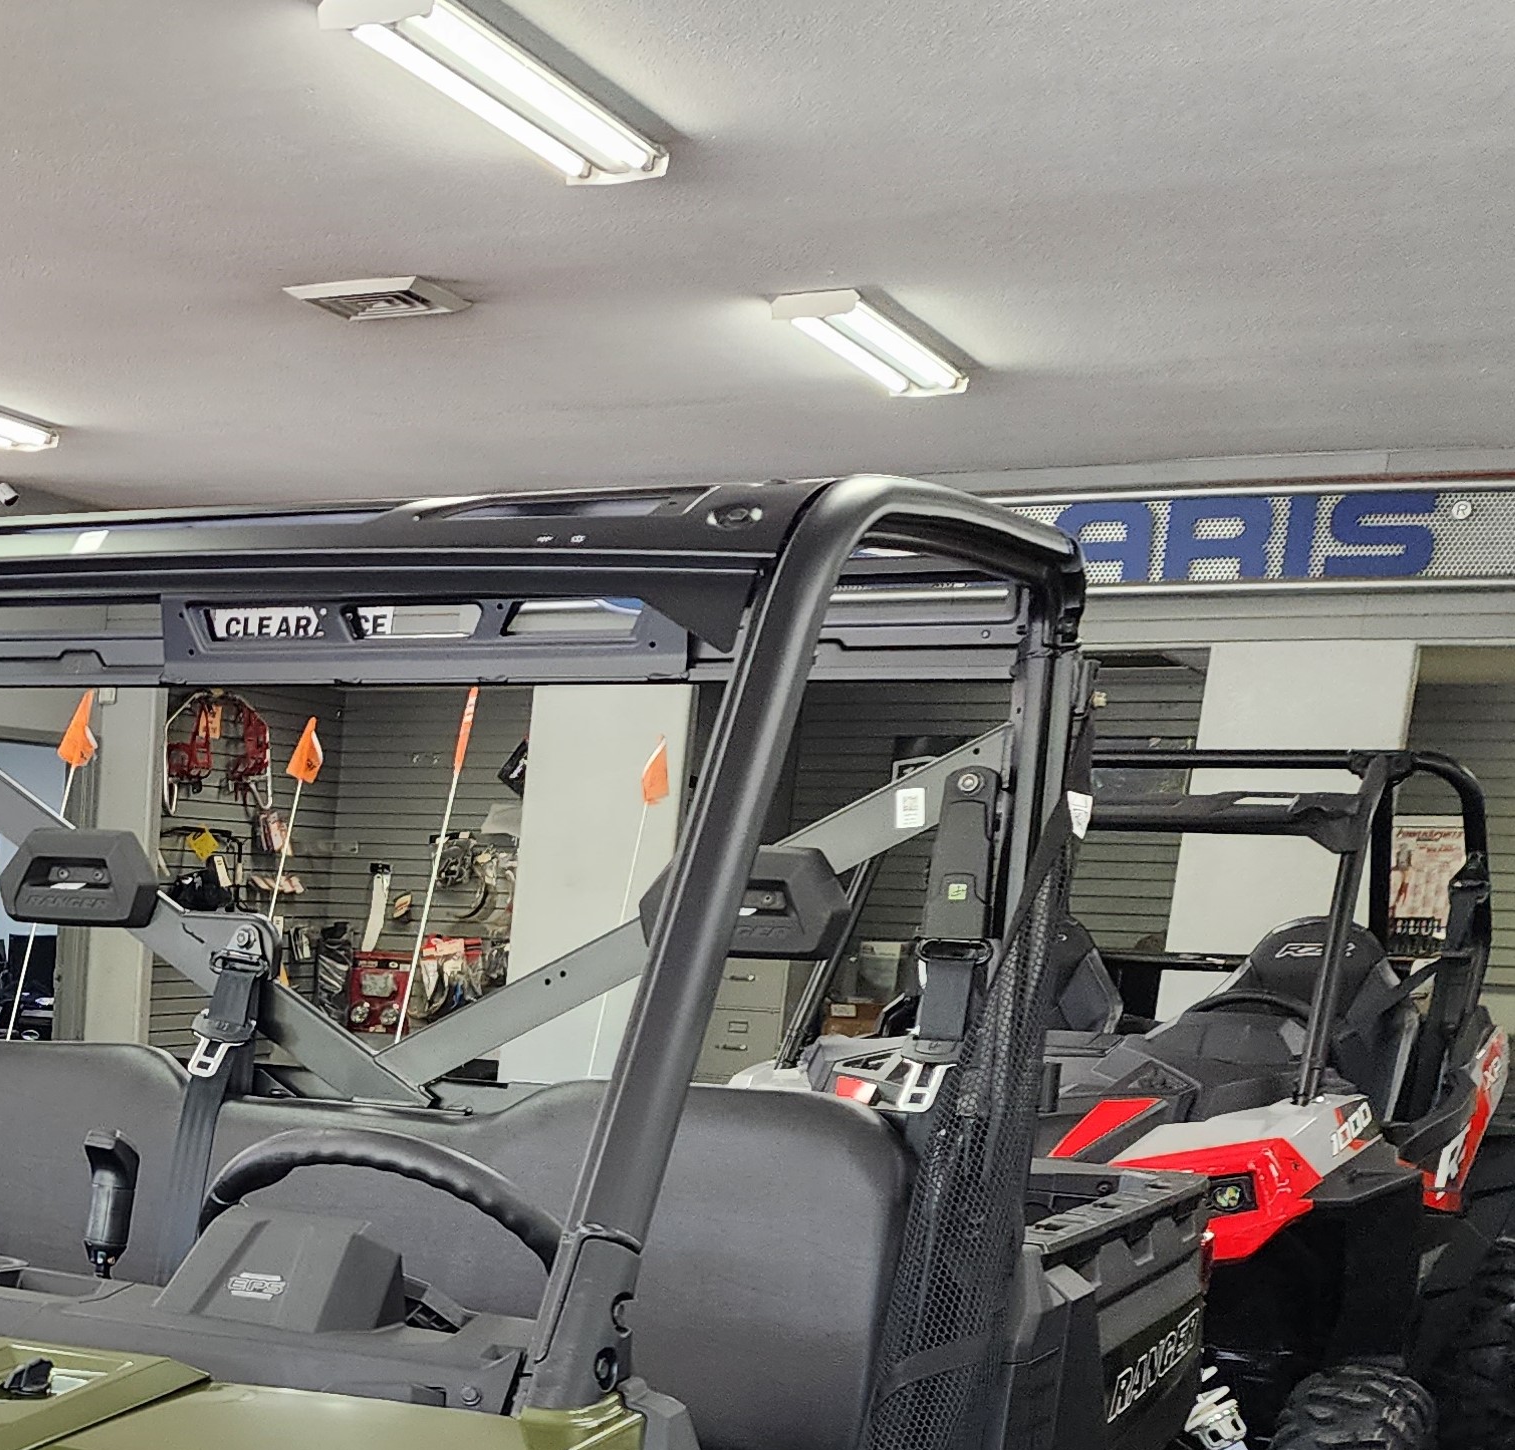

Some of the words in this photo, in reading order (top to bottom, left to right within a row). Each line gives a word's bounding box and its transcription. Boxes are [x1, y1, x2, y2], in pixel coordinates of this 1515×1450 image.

[225, 614, 388, 638] CLEARCE
[24, 893, 108, 910] RANGER
[1330, 1101, 1373, 1158] 1000
[227, 1275, 286, 1296] EPS
[1106, 1307, 1201, 1425] RANGER
